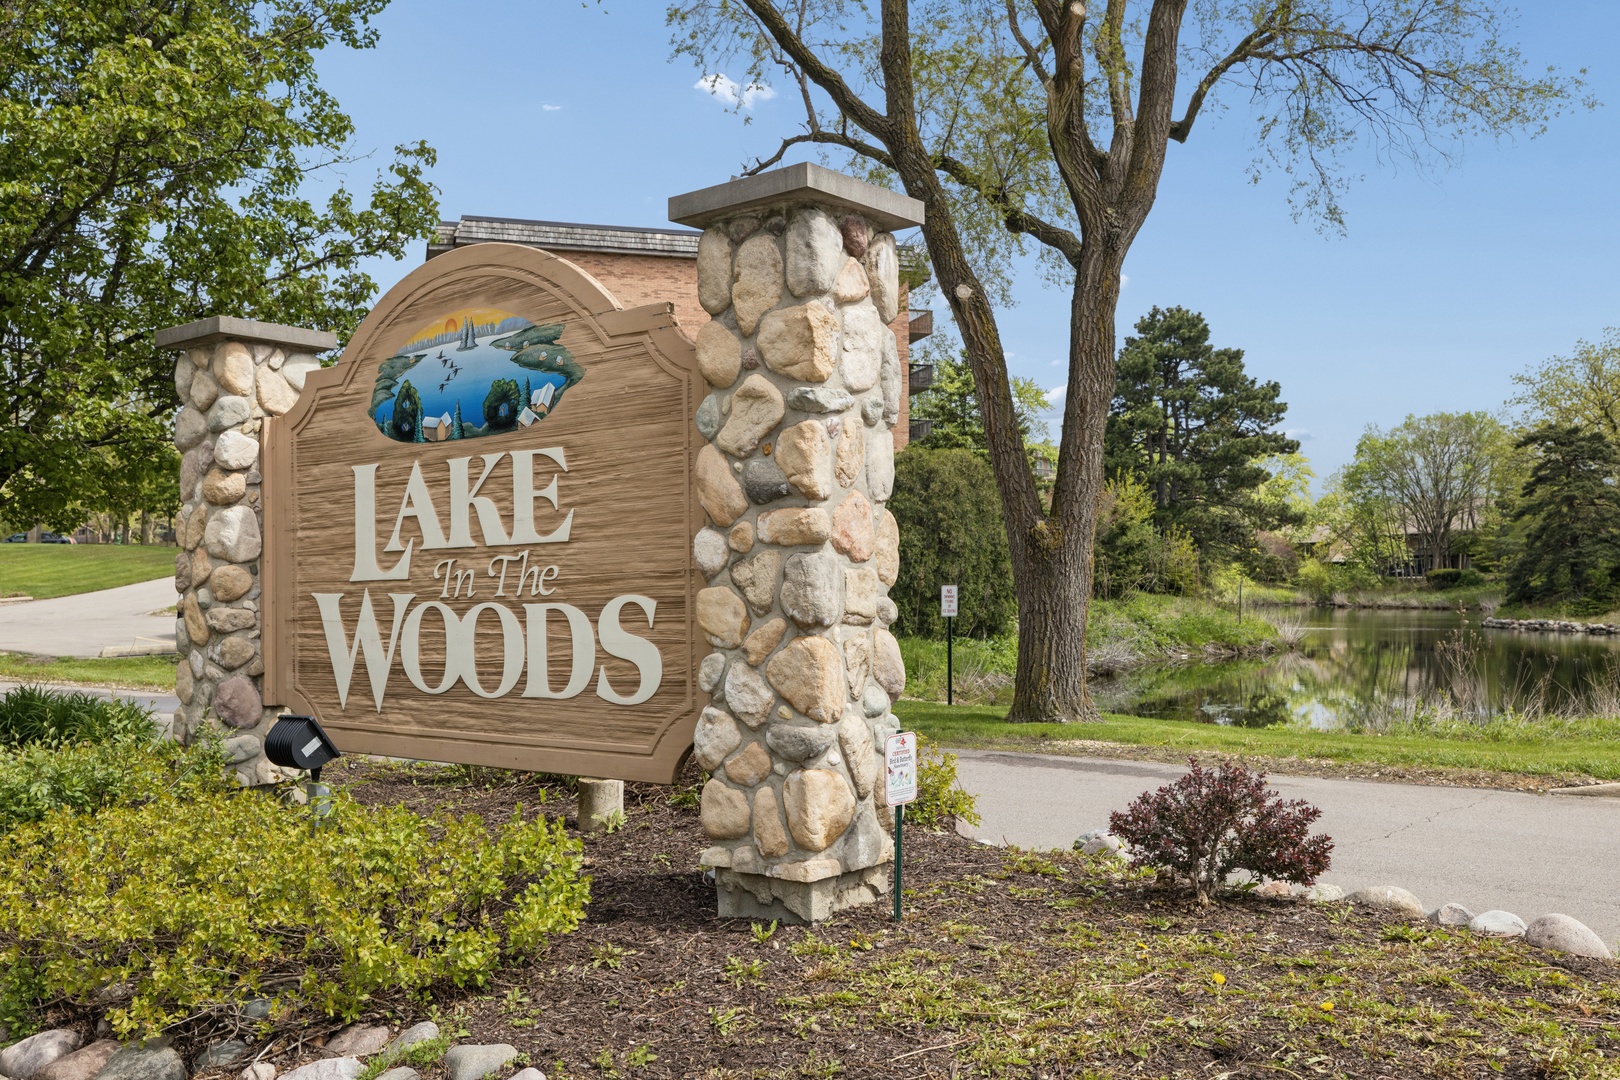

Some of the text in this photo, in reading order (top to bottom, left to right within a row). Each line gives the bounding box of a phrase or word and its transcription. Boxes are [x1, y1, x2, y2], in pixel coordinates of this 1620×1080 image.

[350, 446, 575, 582] LAKE
[433, 550, 560, 599] In The
[311, 587, 663, 714] WOODS
